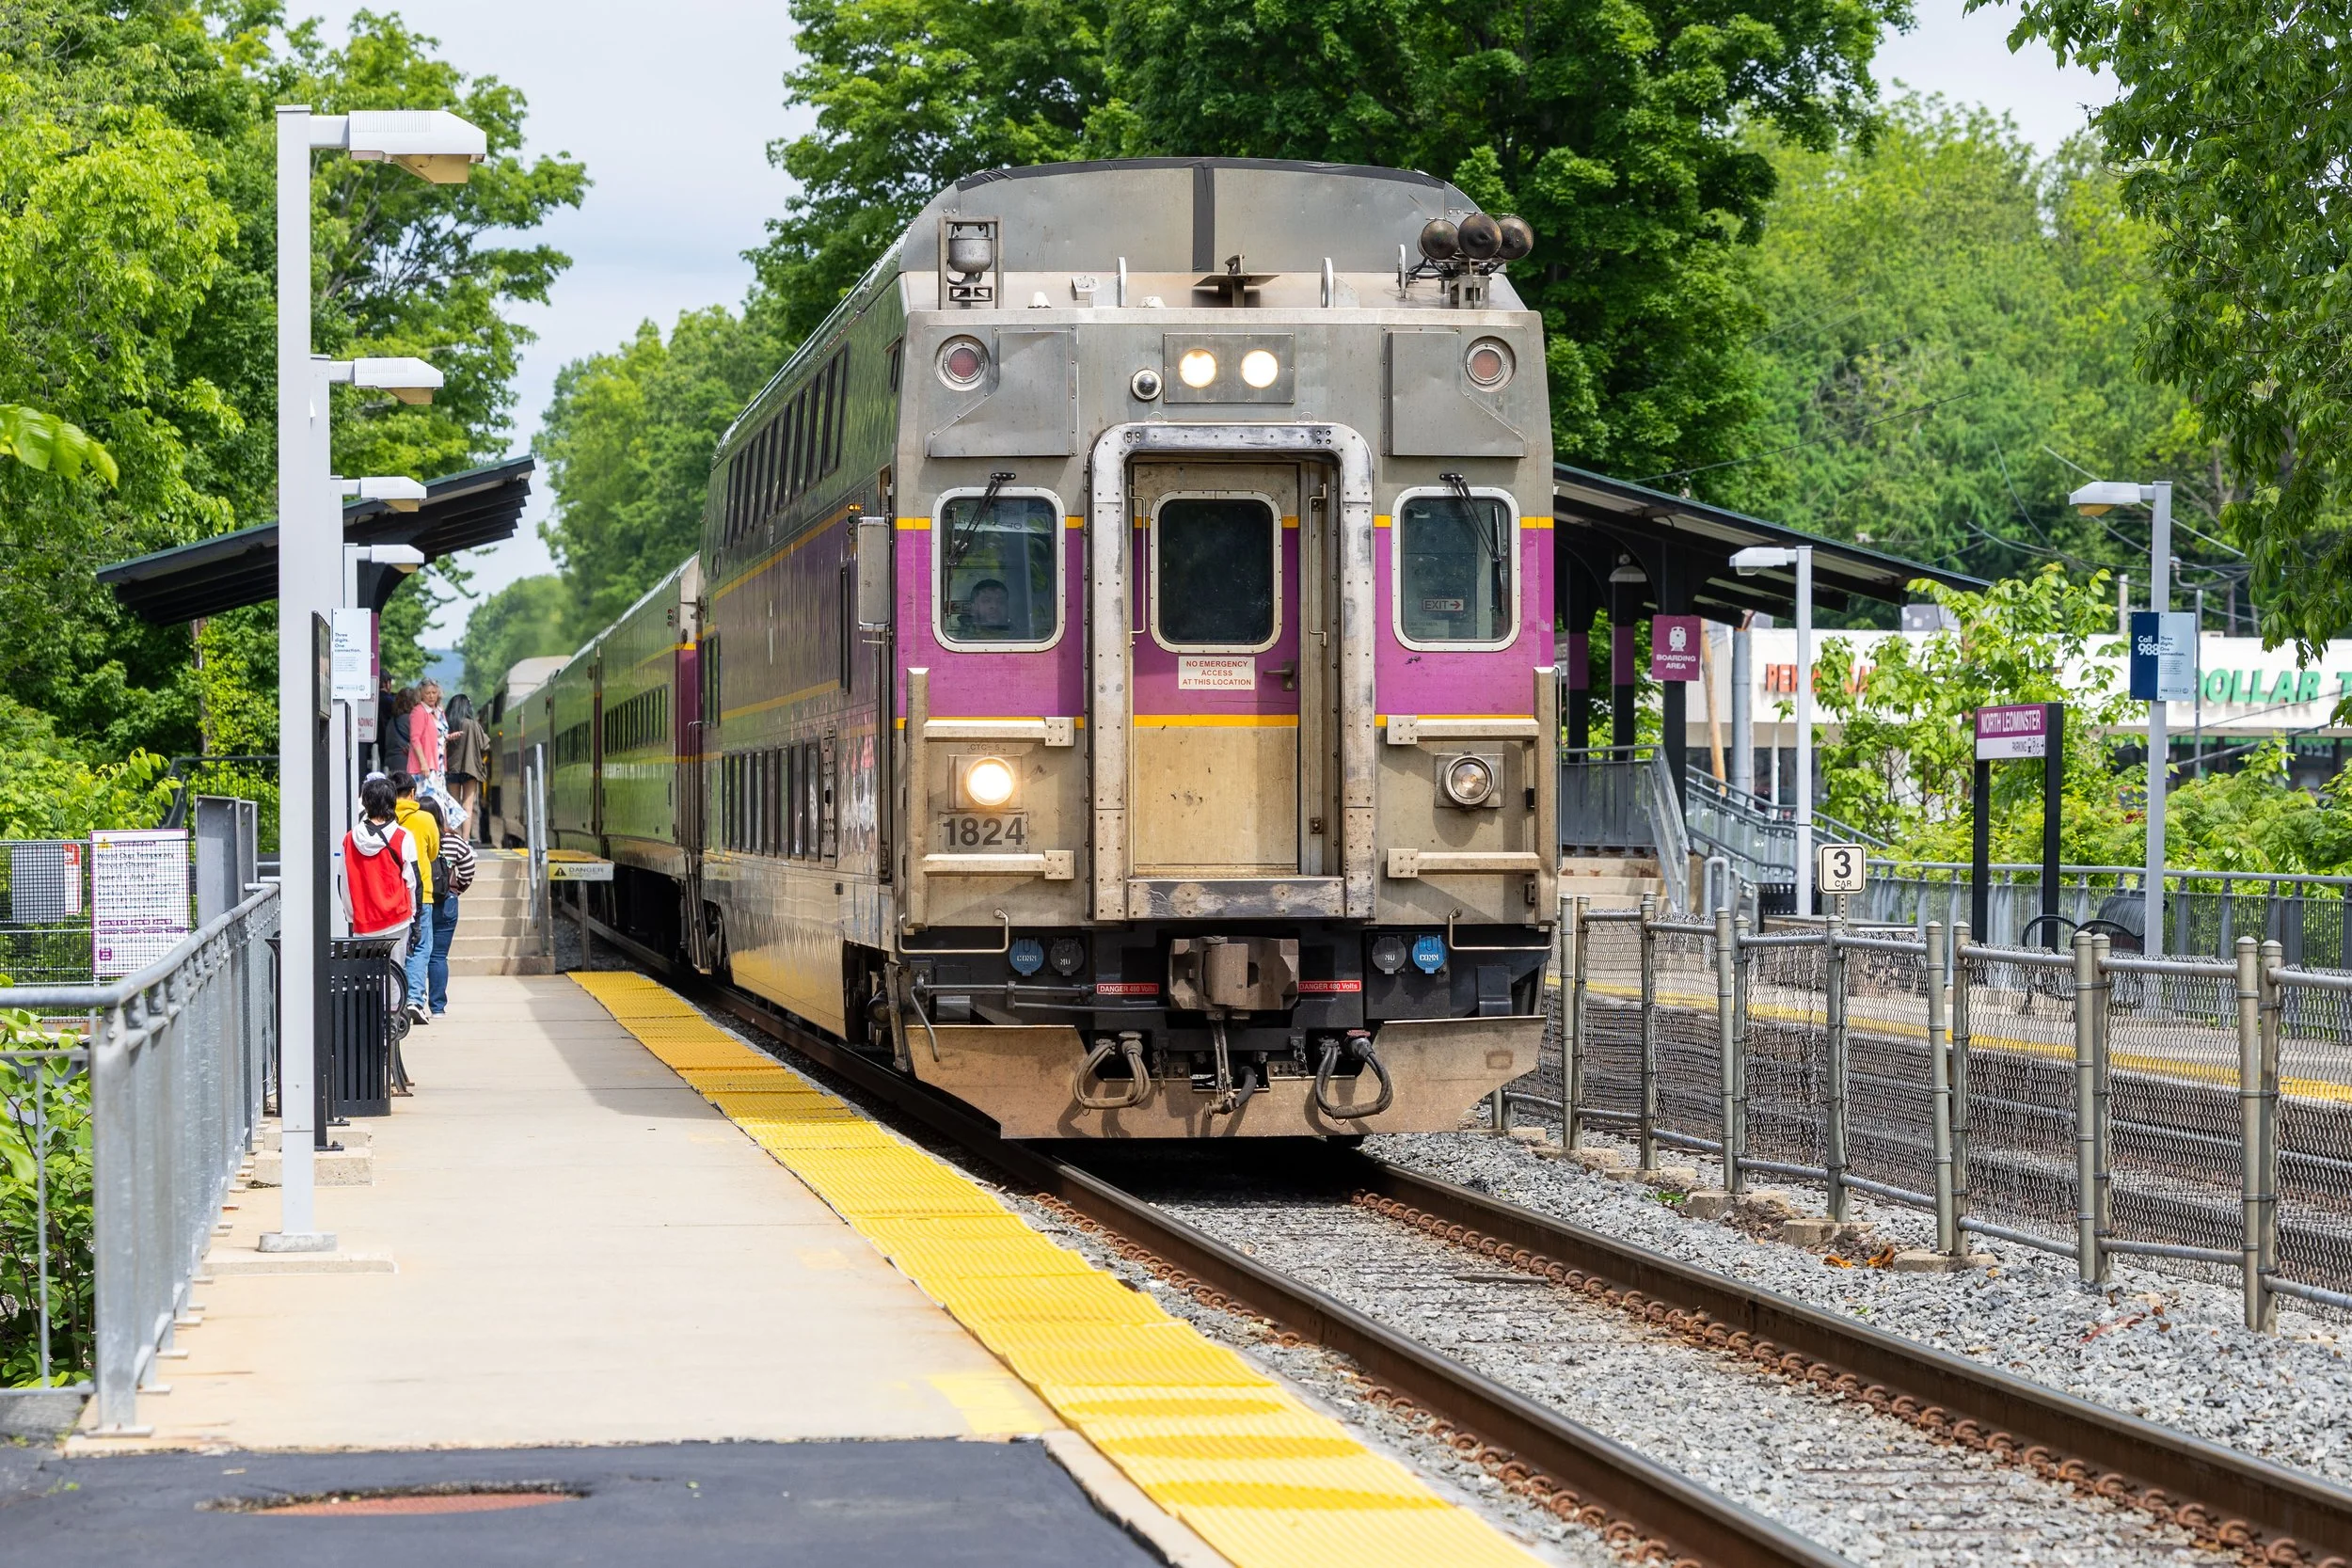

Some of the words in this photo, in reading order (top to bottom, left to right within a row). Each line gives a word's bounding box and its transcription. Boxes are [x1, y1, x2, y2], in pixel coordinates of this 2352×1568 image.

[1424, 600, 1448, 610] EXIT
[2137, 635, 2153, 643] Call
[2137, 643, 2158, 656] 988
[1657, 654, 1696, 662] BOARDING
[1981, 712, 2002, 734] NORTH
[2002, 709, 2041, 733] LEOMINSTER
[943, 816, 1025, 847] 1824
[1834, 850, 1851, 879] 3
